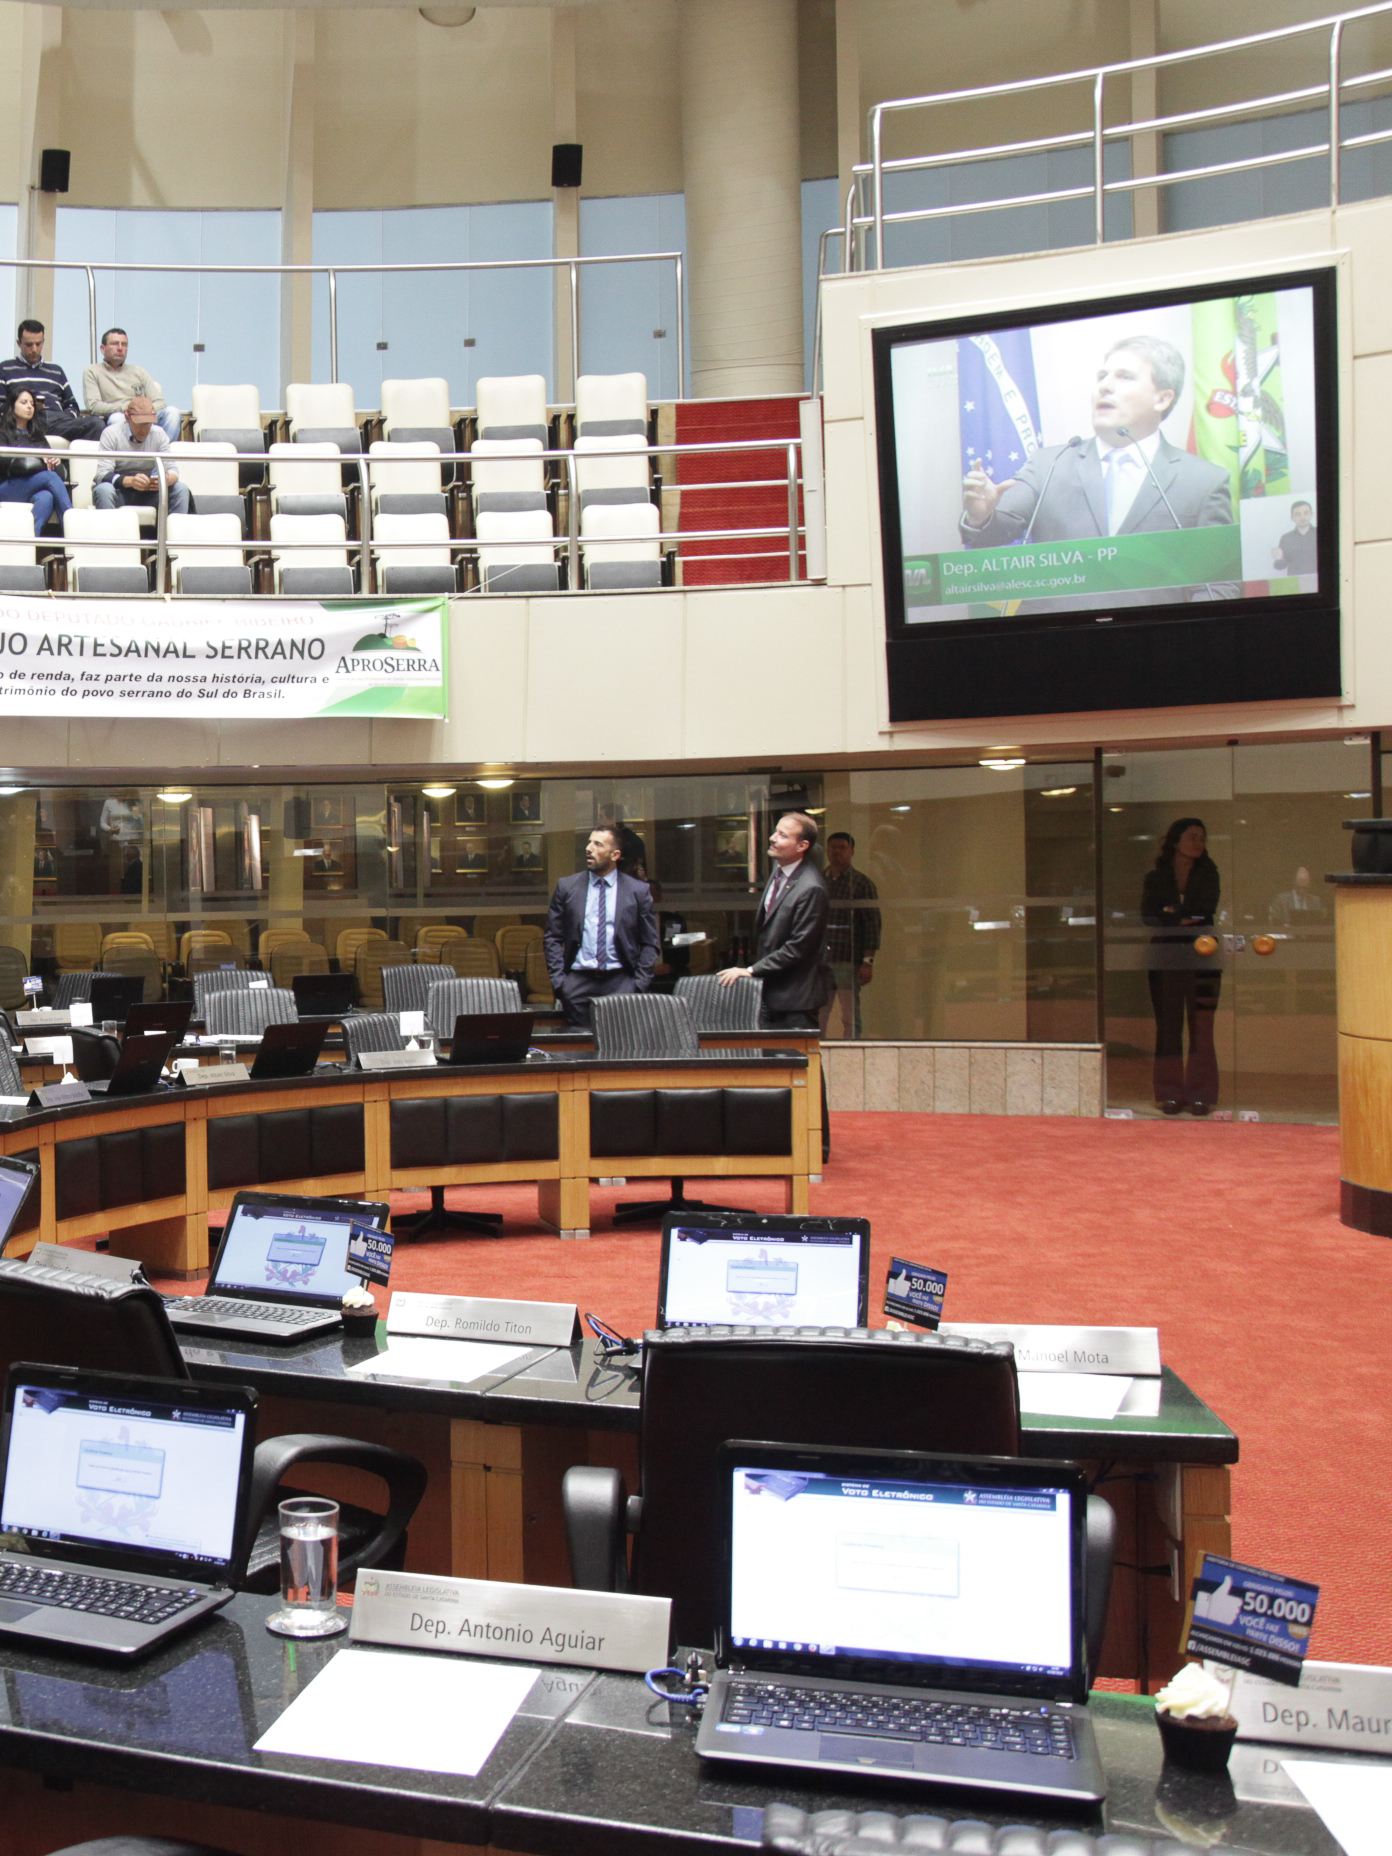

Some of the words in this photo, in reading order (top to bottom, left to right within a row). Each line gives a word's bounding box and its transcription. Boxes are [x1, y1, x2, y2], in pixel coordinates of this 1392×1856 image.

[943, 563, 978, 577] Dep.
[981, 554, 1036, 572] ALTAIR
[1039, 550, 1084, 567] SILVA
[1098, 547, 1118, 561] PP
[945, 573, 1086, 595] altairsilva@alesc.sc.gov.br
[36, 633, 196, 660] ARTESANAL
[205, 637, 326, 661] SERRANO
[9, 669, 26, 680] de
[30, 670, 75, 683] renda,
[80, 671, 100, 682] faz
[104, 672, 142, 684] parte
[147, 672, 163, 683] da
[168, 674, 207, 684] nossa
[211, 672, 265, 686] história,
[270, 673, 317, 684] cultura
[321, 675, 330, 685] e
[61, 686, 78, 698] do
[82, 688, 114, 699] povo
[119, 688, 172, 699] serrano
[176, 688, 193, 699] do
[197, 687, 218, 700] Sul
[222, 688, 239, 700] do
[243, 688, 285, 700] Brasil.
[368, 1239, 392, 1254] 50.000
[911, 1278, 944, 1295] 50.000
[426, 1316, 450, 1330] Dep.
[454, 1318, 500, 1332] Romildo
[505, 1321, 532, 1334] Titon
[1018, 1349, 1068, 1363] Manoel
[1074, 1350, 1109, 1364] Mota
[89, 1403, 107, 1412] VOTO
[109, 1406, 152, 1417] ELETRÔNICO
[841, 1487, 869, 1497] VOTO
[872, 1489, 934, 1501] ELETRÔNICO
[422, 1586, 459, 1596] LEGISLATIVA
[1243, 1591, 1311, 1624] 50.000
[1239, 1613, 1265, 1630] VOCÊ
[410, 1612, 451, 1639] Dep.
[459, 1618, 534, 1644] Antonio
[540, 1627, 605, 1653] Aguiar
[1269, 1634, 1301, 1653] DISSO!
[1262, 1701, 1317, 1732] Dep.
